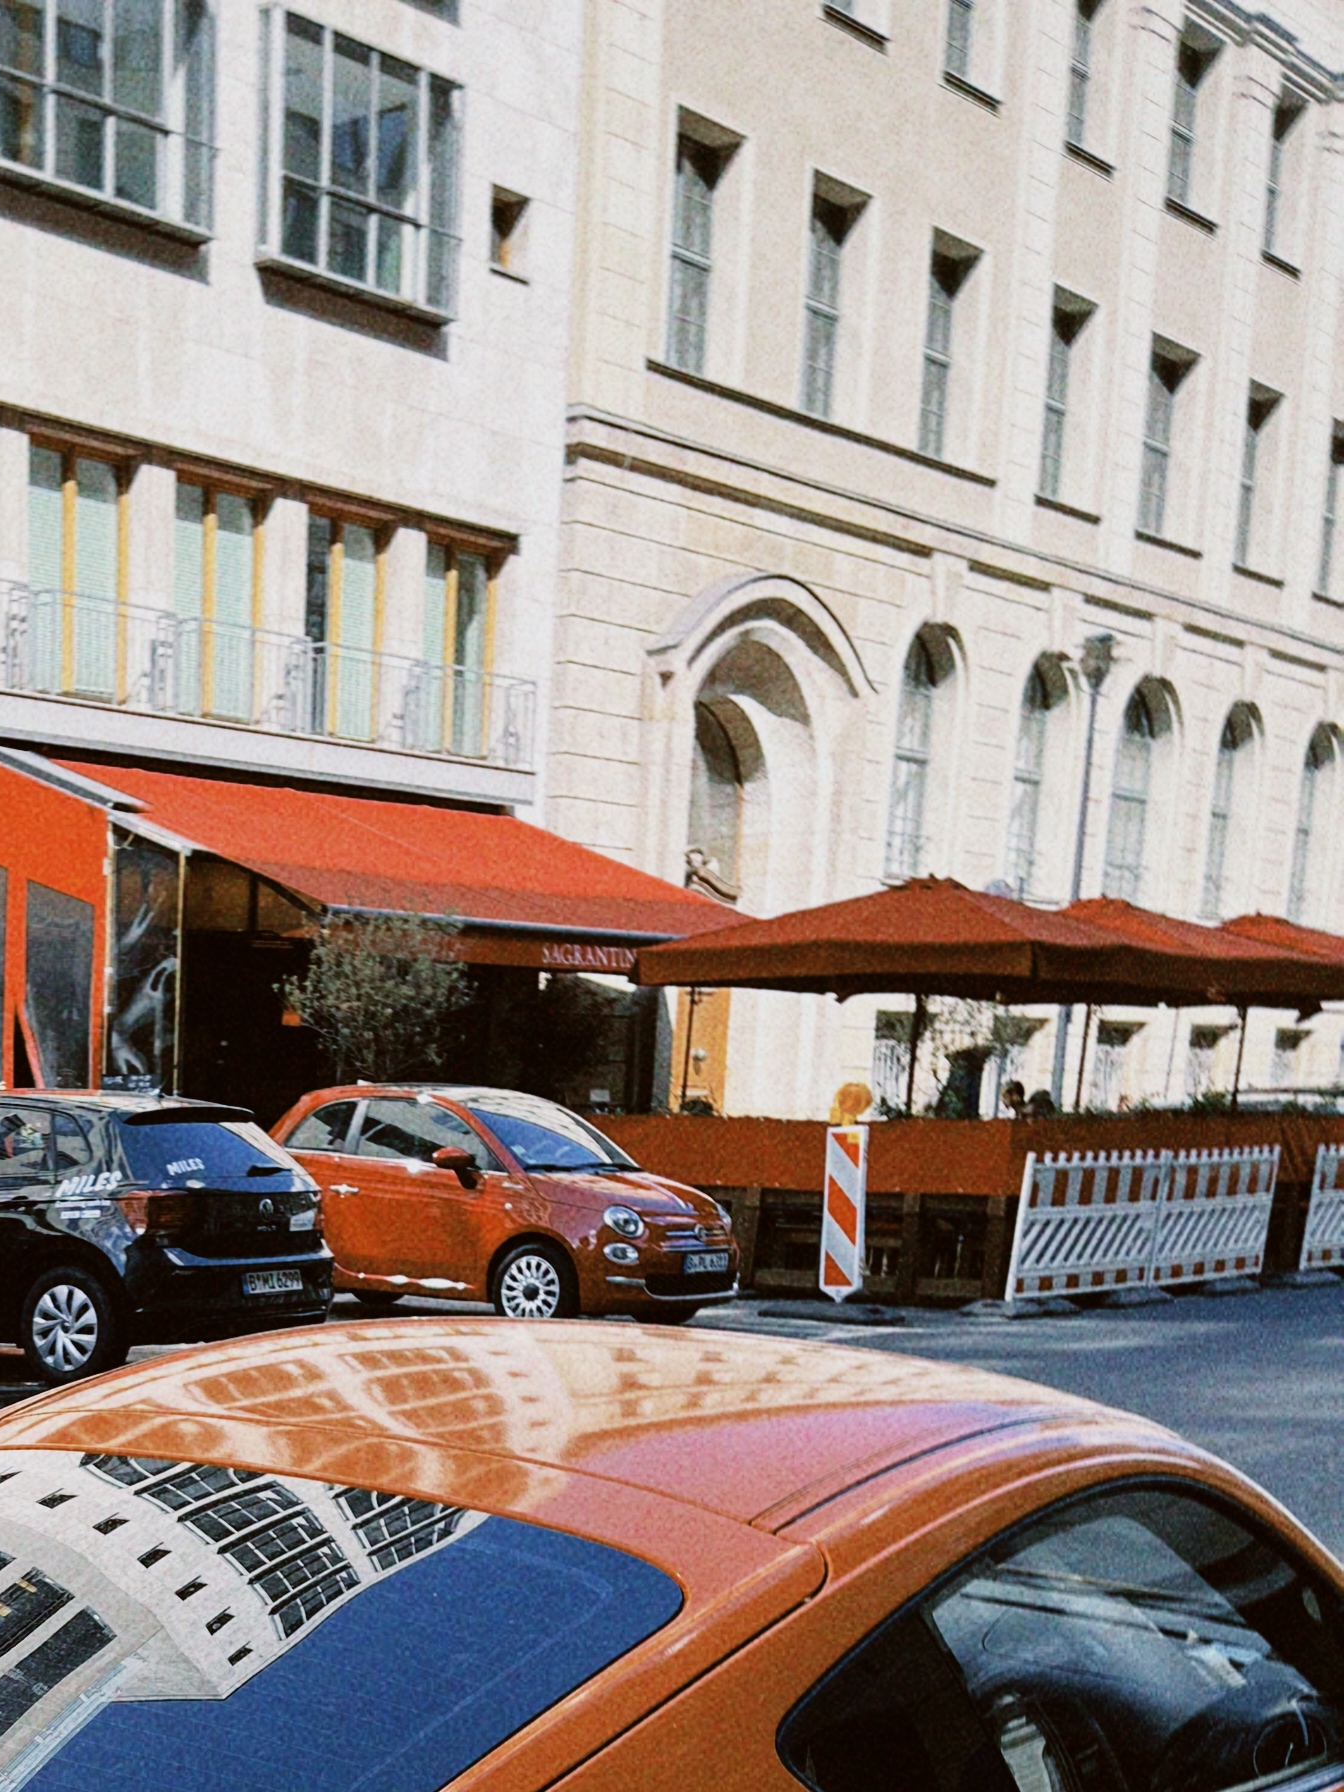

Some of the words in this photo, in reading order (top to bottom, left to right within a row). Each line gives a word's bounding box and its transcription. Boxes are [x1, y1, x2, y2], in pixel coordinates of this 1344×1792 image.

[165, 1157, 205, 1176] MILES
[55, 1170, 123, 1198] MILES
[248, 1273, 257, 1292] B
